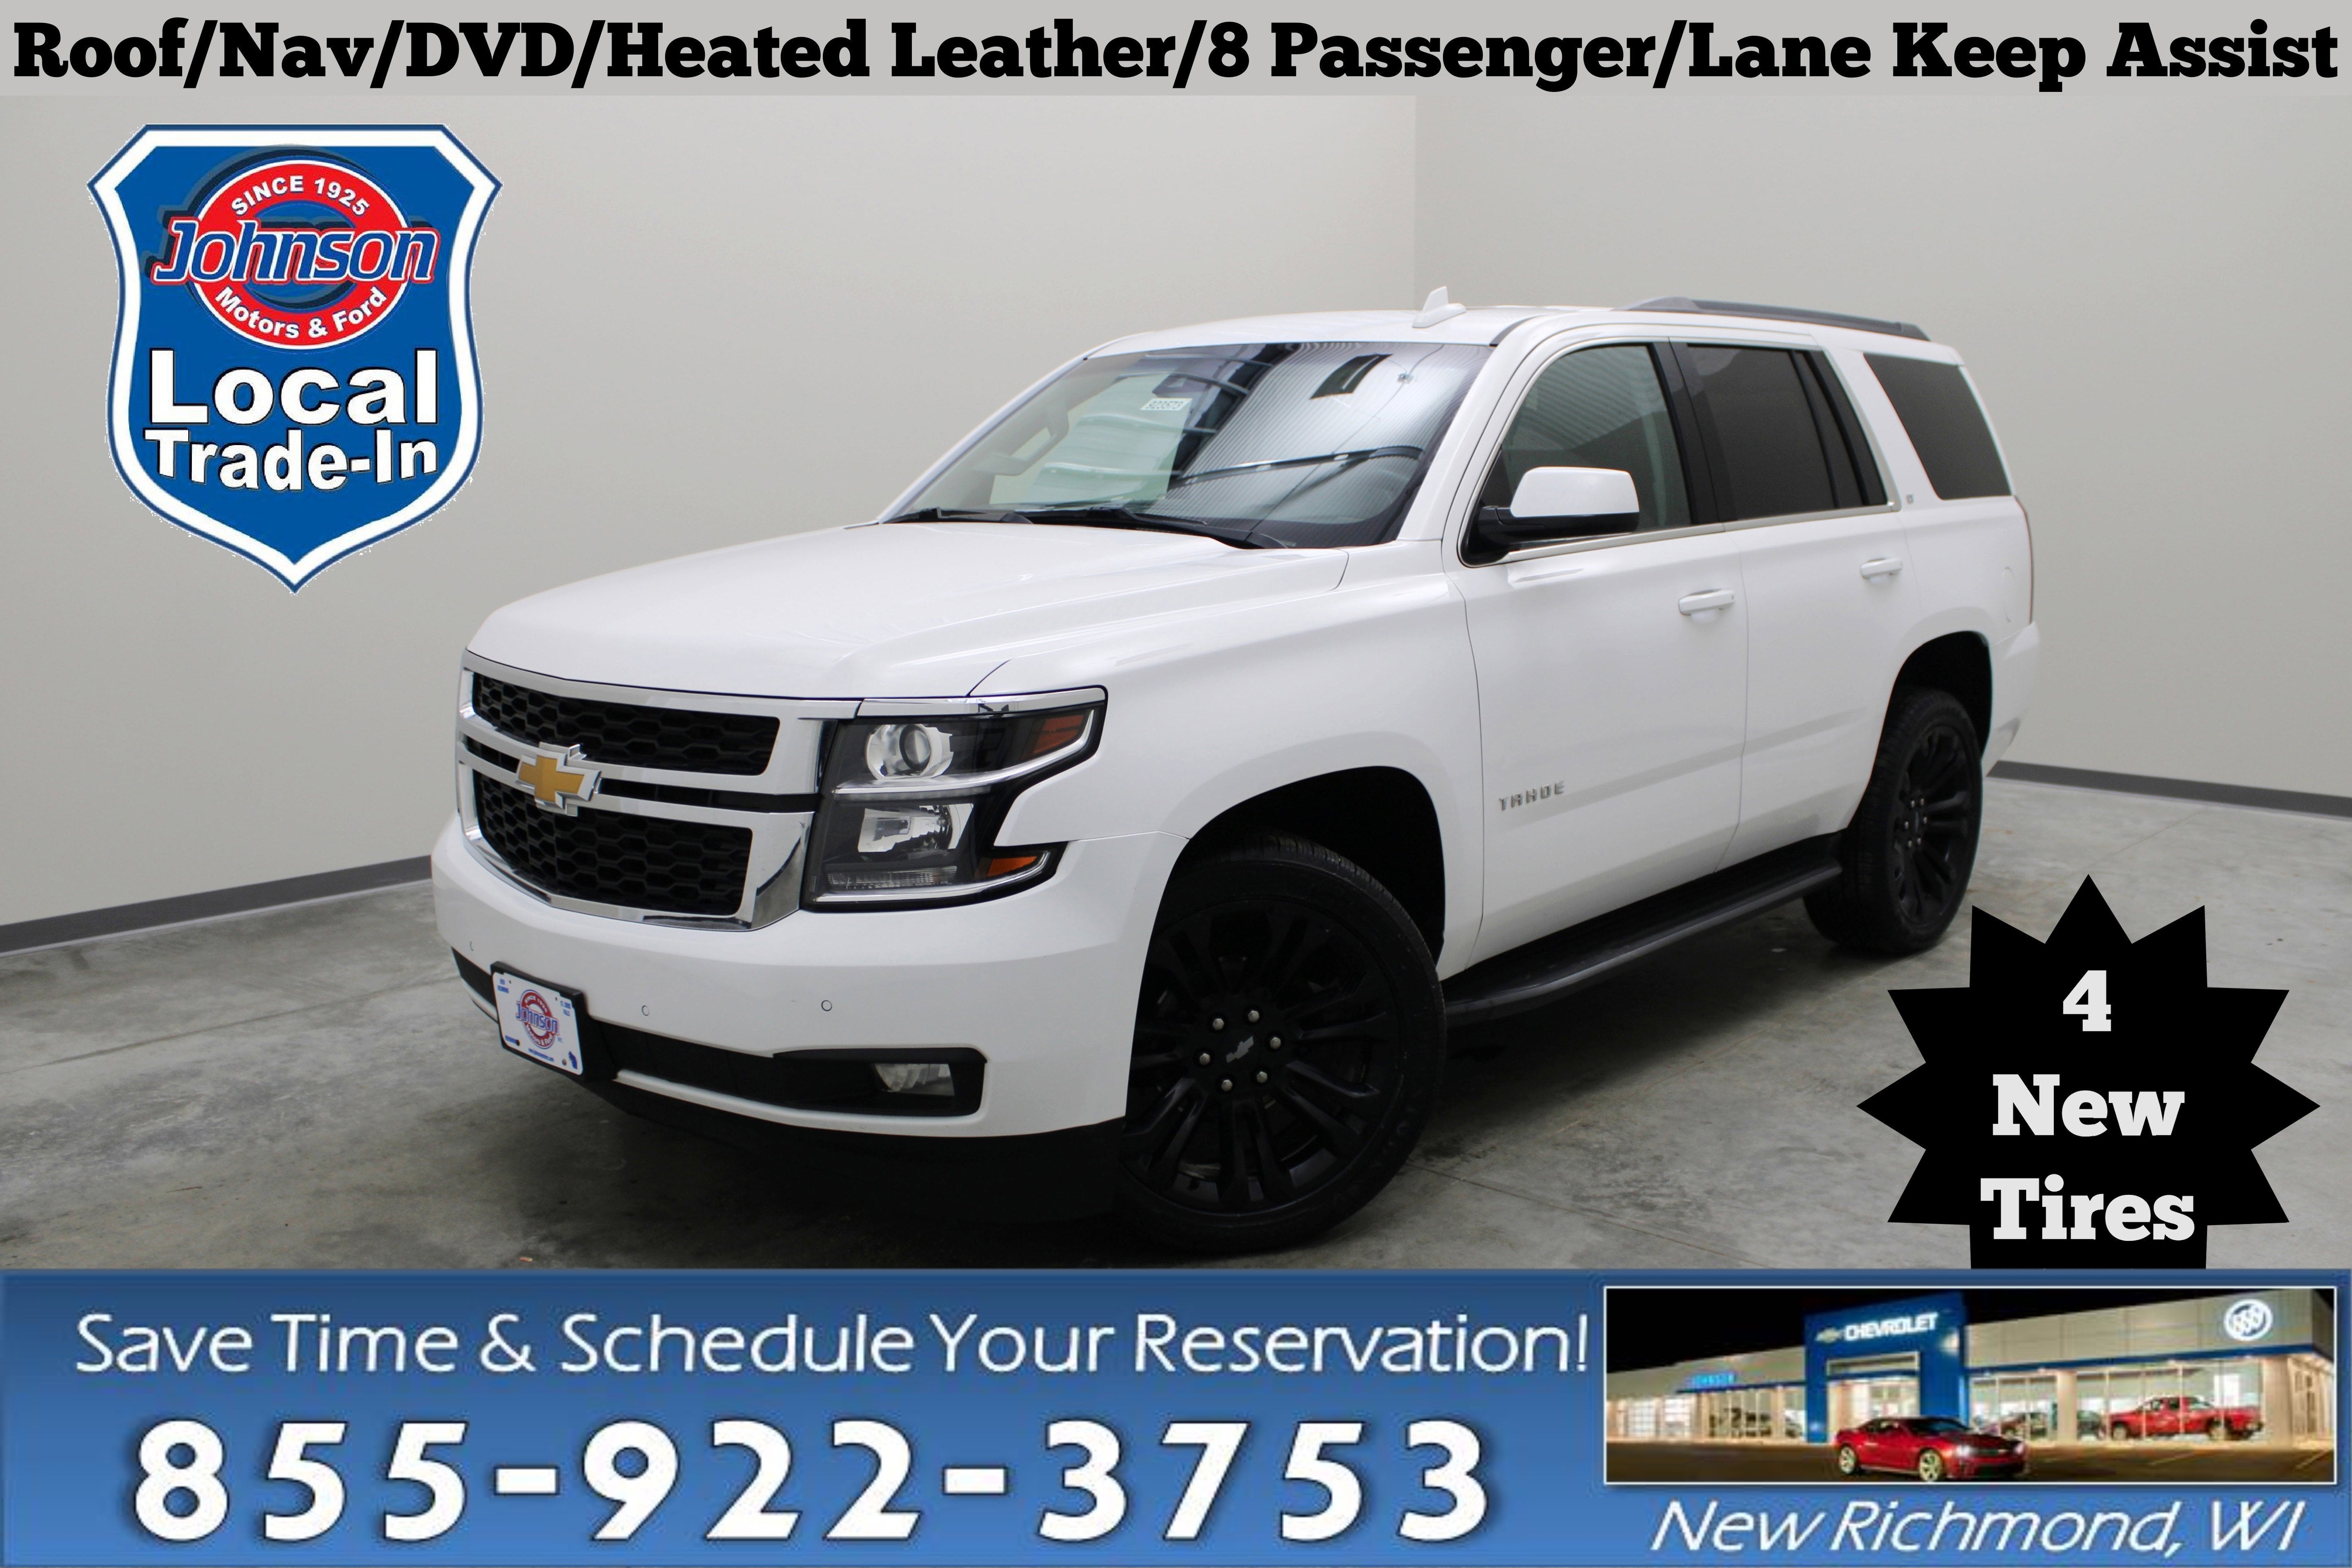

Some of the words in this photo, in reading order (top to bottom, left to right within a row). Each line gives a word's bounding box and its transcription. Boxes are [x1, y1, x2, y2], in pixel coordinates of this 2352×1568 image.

[1499, 780, 1565, 811] TAHOE
[516, 1001, 559, 1035] Johnson
[1844, 1312, 1938, 1341] CHEVROLET
